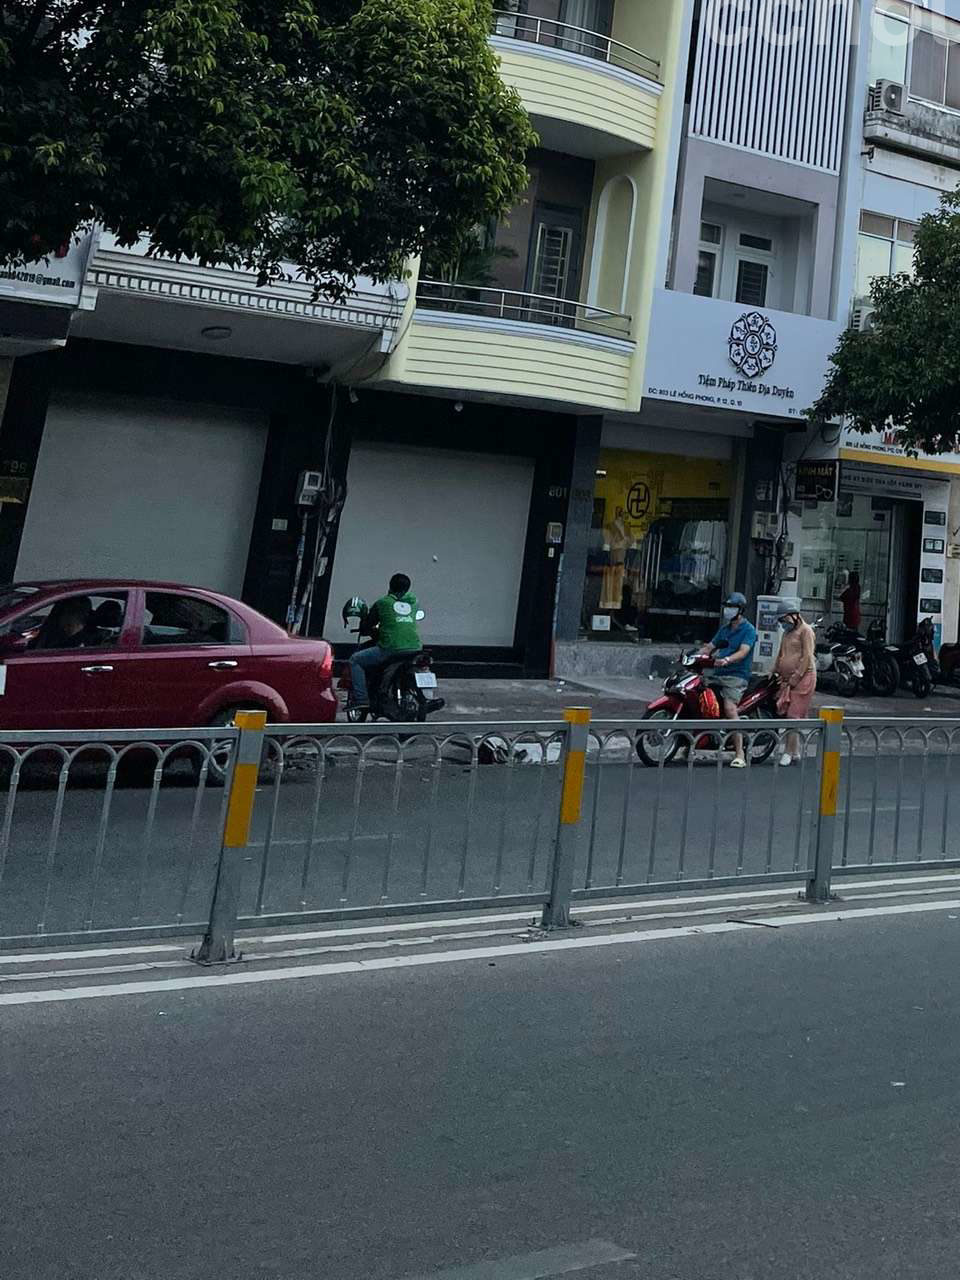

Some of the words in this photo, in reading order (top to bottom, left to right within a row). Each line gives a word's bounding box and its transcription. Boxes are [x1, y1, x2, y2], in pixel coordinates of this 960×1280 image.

[698, 374, 717, 389] Tiệm
[718, 377, 736, 392] Pháp
[737, 380, 757, 393] Thiên
[758, 384, 771, 396] Địa
[772, 385, 795, 400] Duyên
